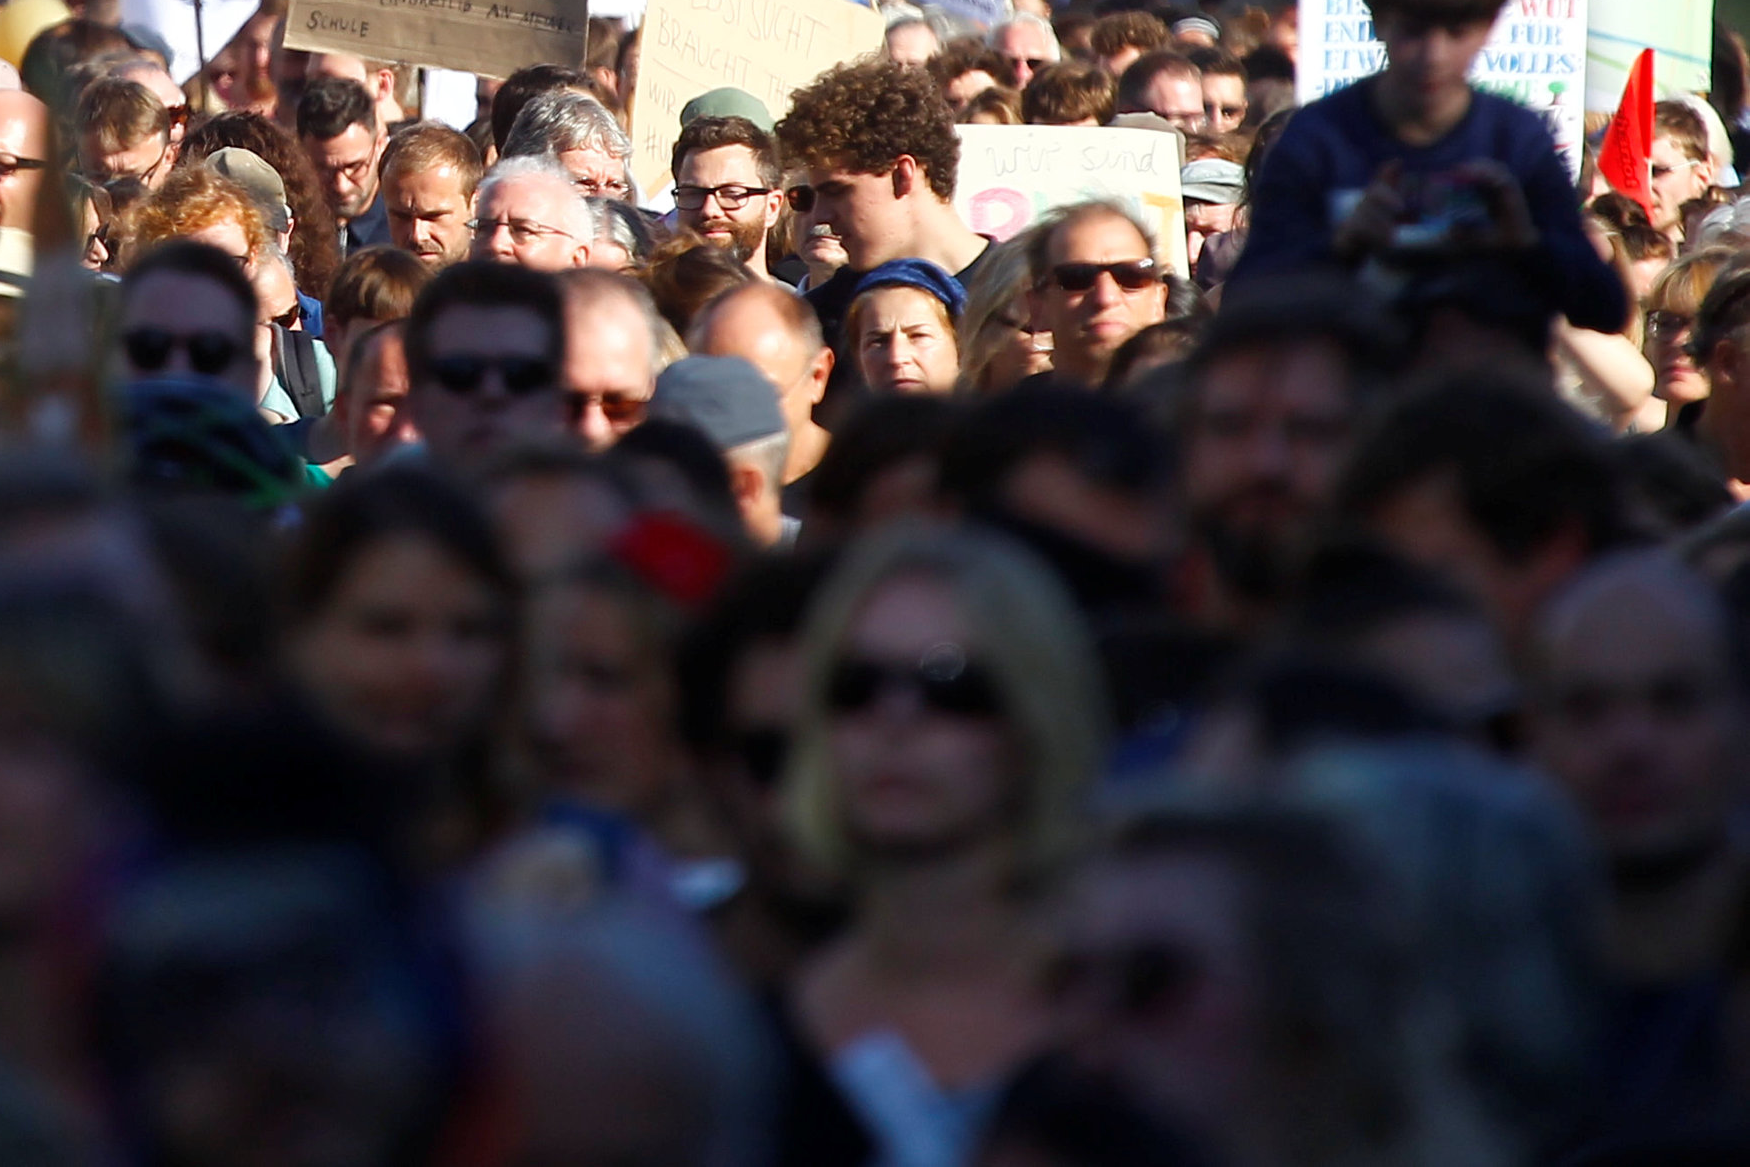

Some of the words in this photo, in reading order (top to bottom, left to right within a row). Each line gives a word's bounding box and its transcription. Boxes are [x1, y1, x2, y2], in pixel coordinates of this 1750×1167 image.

[306, 10, 370, 38] SCHULE
[486, 3, 513, 20] AN
[1510, 19, 1564, 46] FÜR
[657, 6, 753, 89] BRAUCHT
[1481, 50, 1582, 74] VOLLES:
[648, 77, 678, 118] WIR
[642, 124, 672, 164] #U
